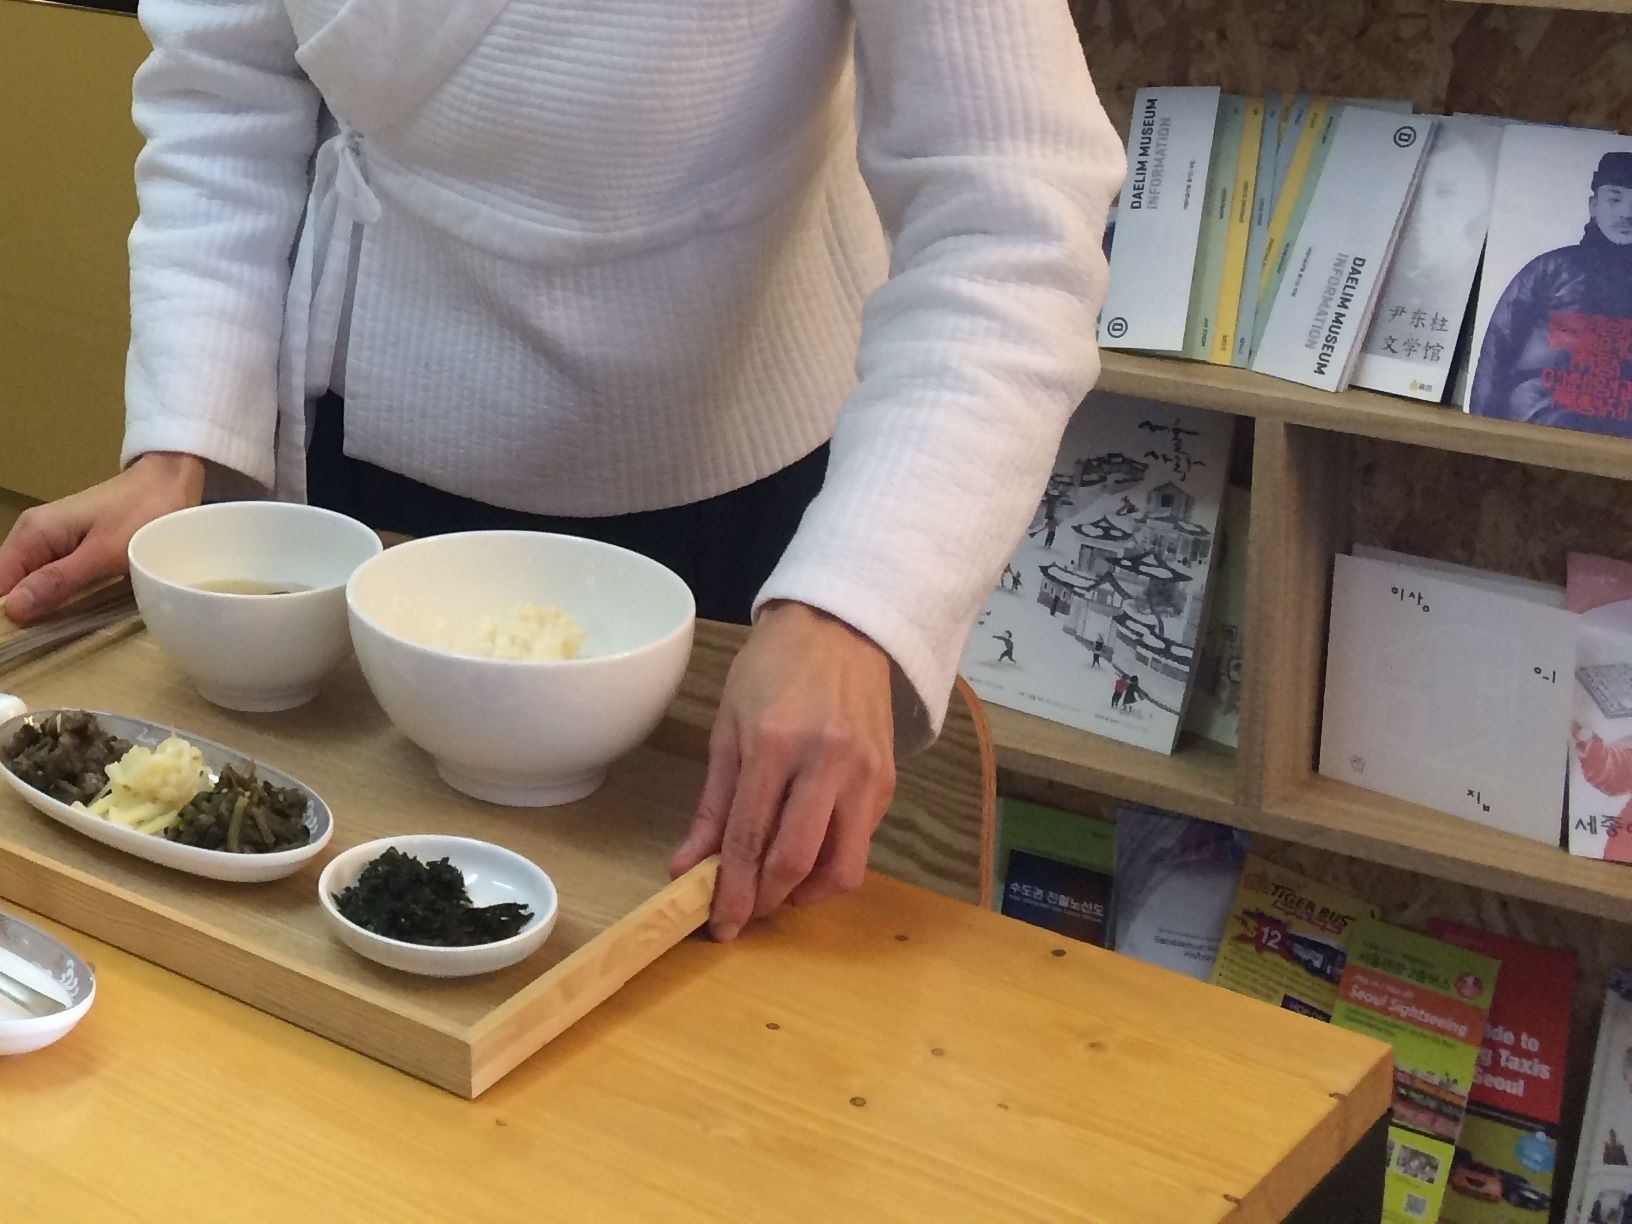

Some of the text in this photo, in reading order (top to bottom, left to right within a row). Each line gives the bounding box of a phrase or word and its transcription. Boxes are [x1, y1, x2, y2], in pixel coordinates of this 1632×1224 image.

[1130, 98, 1158, 210] DAELIM MUSEUM
[1146, 117, 1171, 210] INFORMATION
[1304, 252, 1349, 351] INFORMATION
[1313, 256, 1367, 376] DAELIM MUSEUM
[1388, 305, 1449, 333] 尹东柱
[1382, 335, 1445, 362] 文学馆
[1391, 586, 1430, 613] 이상
[1534, 666, 1557, 684] 의
[1467, 789, 1491, 812] 집
[1009, 881, 1044, 901] 수도권
[1271, 883, 1317, 914] TIGER
[1318, 906, 1356, 928] BUS
[1349, 983, 1389, 1008] Seoul
[1388, 997, 1468, 1038] Sightseeing
[1521, 1031, 1540, 1053] to
[1499, 1047, 1551, 1080] Taxis
